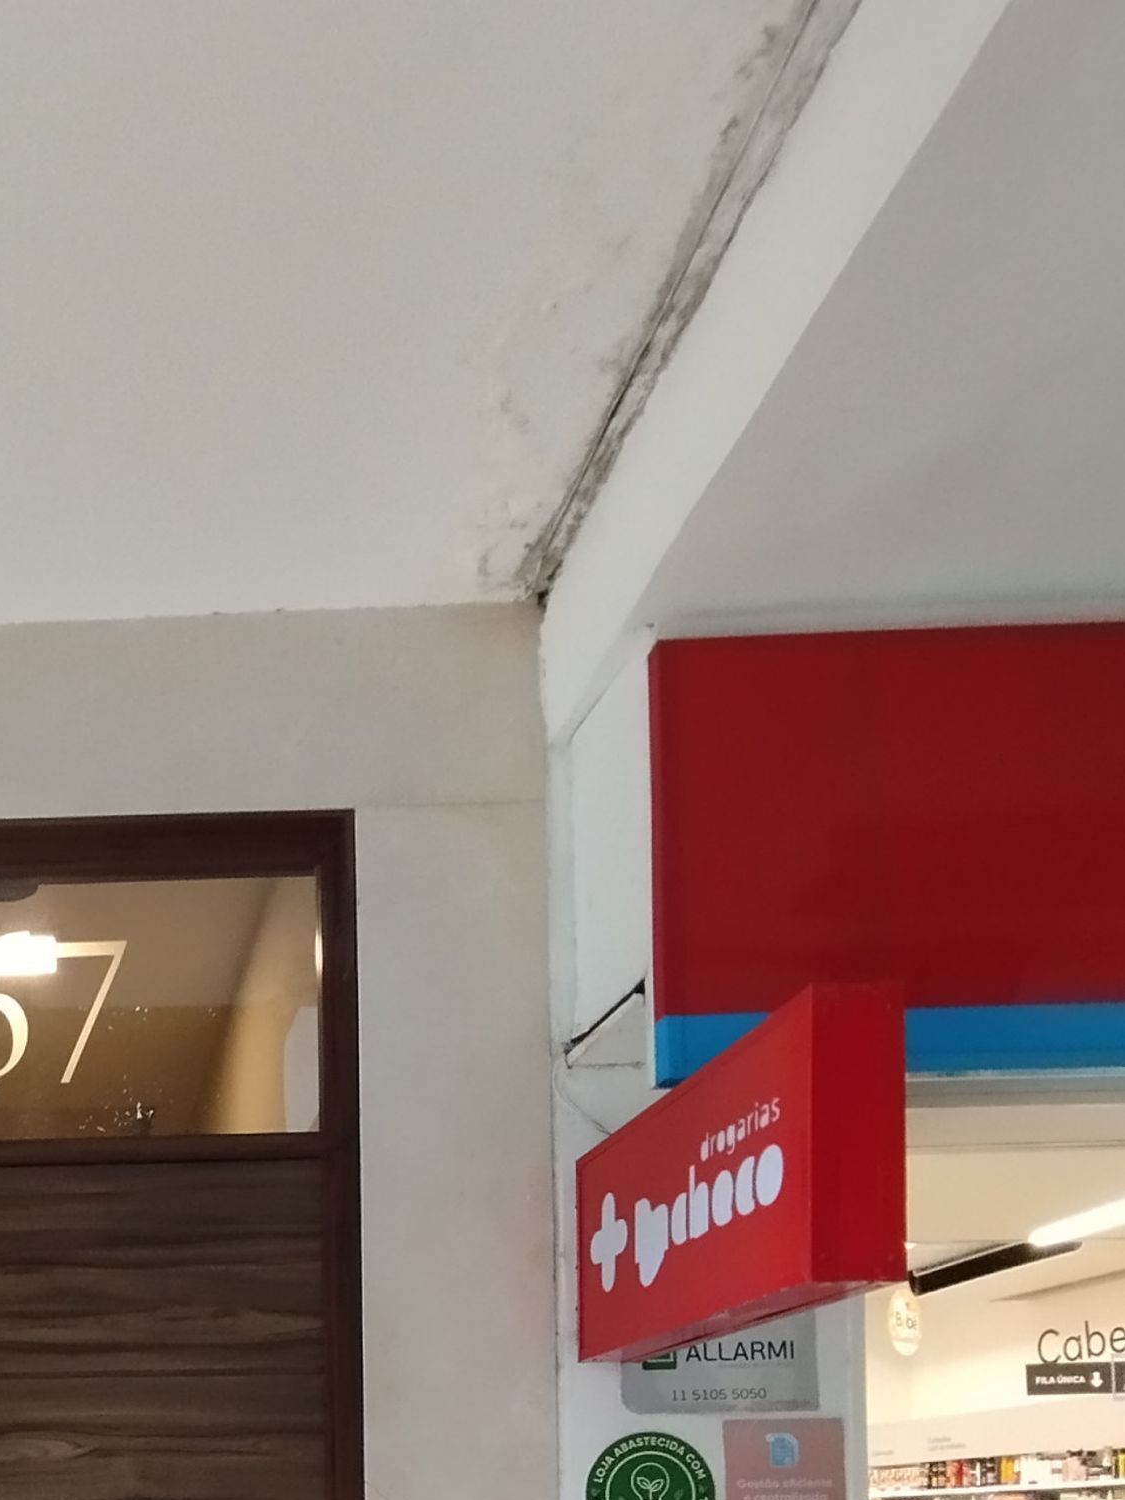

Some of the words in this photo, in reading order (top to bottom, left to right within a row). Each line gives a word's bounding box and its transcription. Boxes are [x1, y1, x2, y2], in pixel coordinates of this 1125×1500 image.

[700, 1098, 780, 1162] drogarias
[634, 1143, 784, 1287] pacheco
[685, 1340, 795, 1363] ALLARMI
[1035, 1376, 1055, 1385] FILA
[672, 1389, 686, 1401] 11
[692, 1388, 727, 1401] 5105
[732, 1387, 767, 1400] 5050
[594, 1456, 614, 1483] LOJA
[614, 1436, 686, 1457] ABASTECIDA
[686, 1453, 707, 1480] COM
[736, 1478, 780, 1489] Gestão
